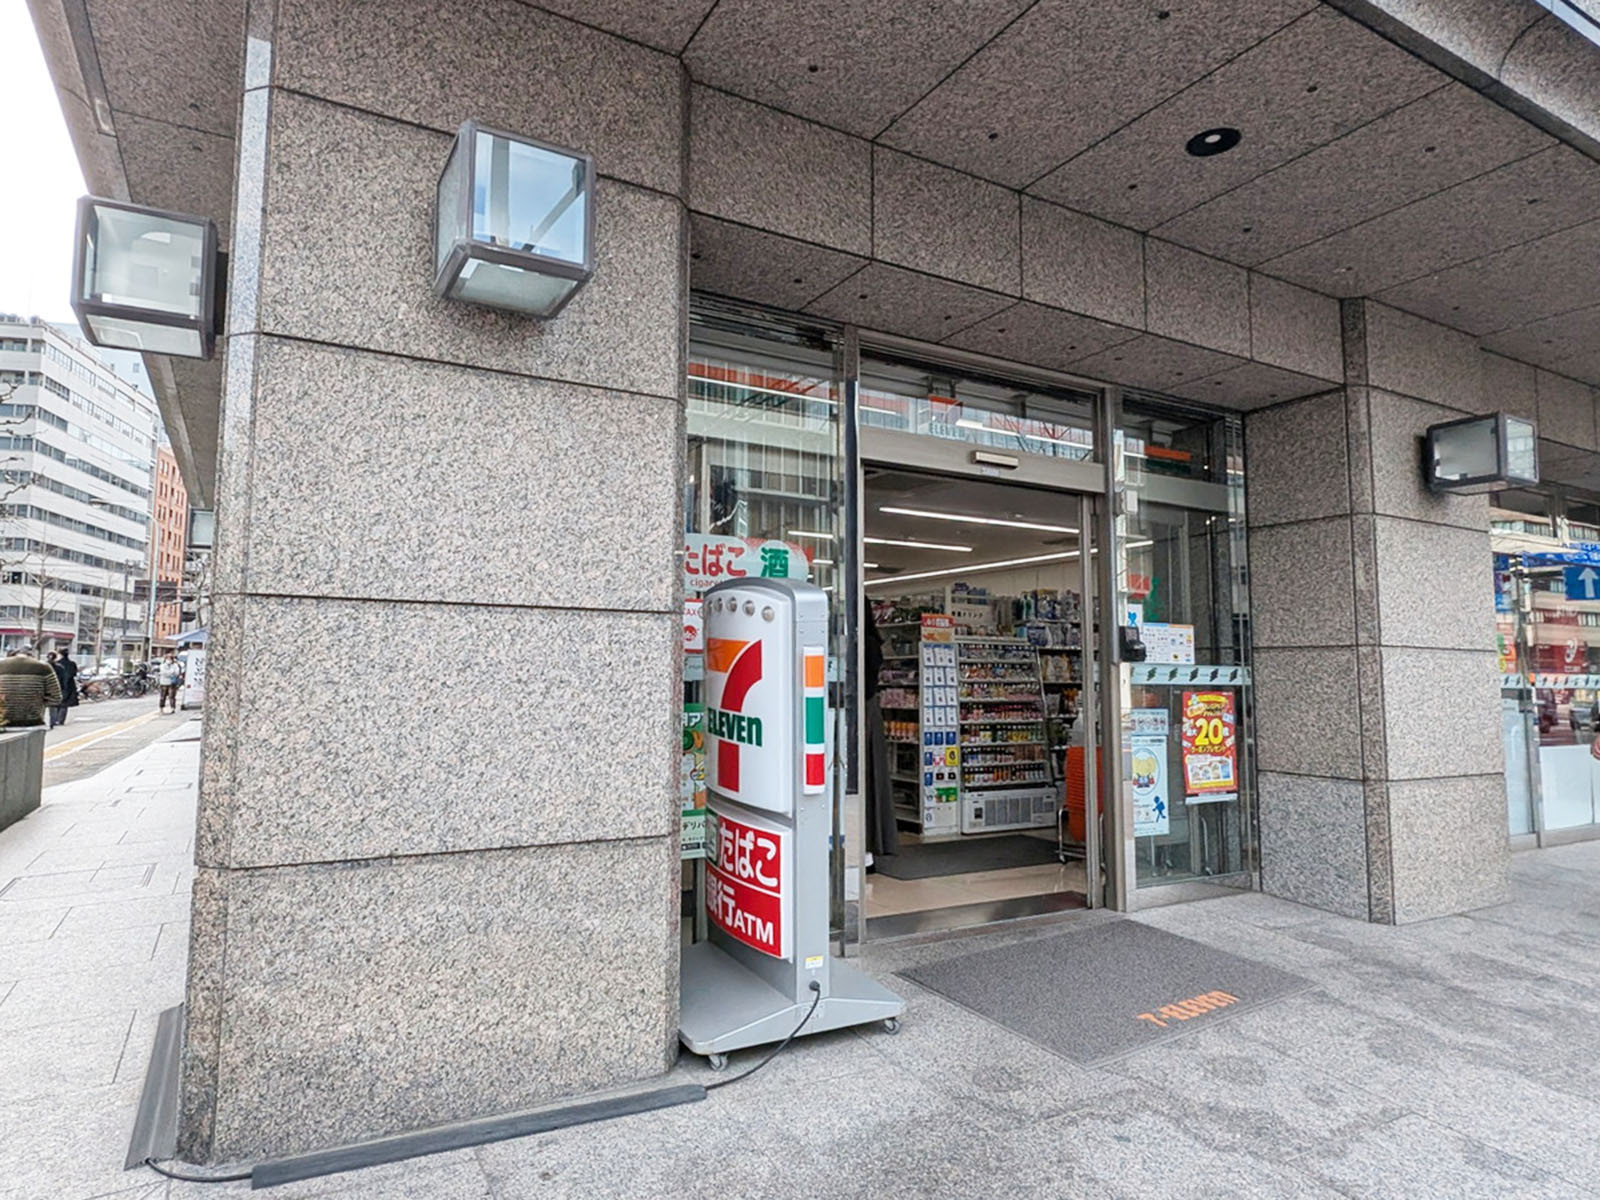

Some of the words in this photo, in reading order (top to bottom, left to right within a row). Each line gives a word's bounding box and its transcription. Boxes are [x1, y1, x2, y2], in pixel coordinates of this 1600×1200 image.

[760, 546, 789, 577] 酒
[1194, 717, 1224, 746] 20
[719, 822, 779, 887] たばこ
